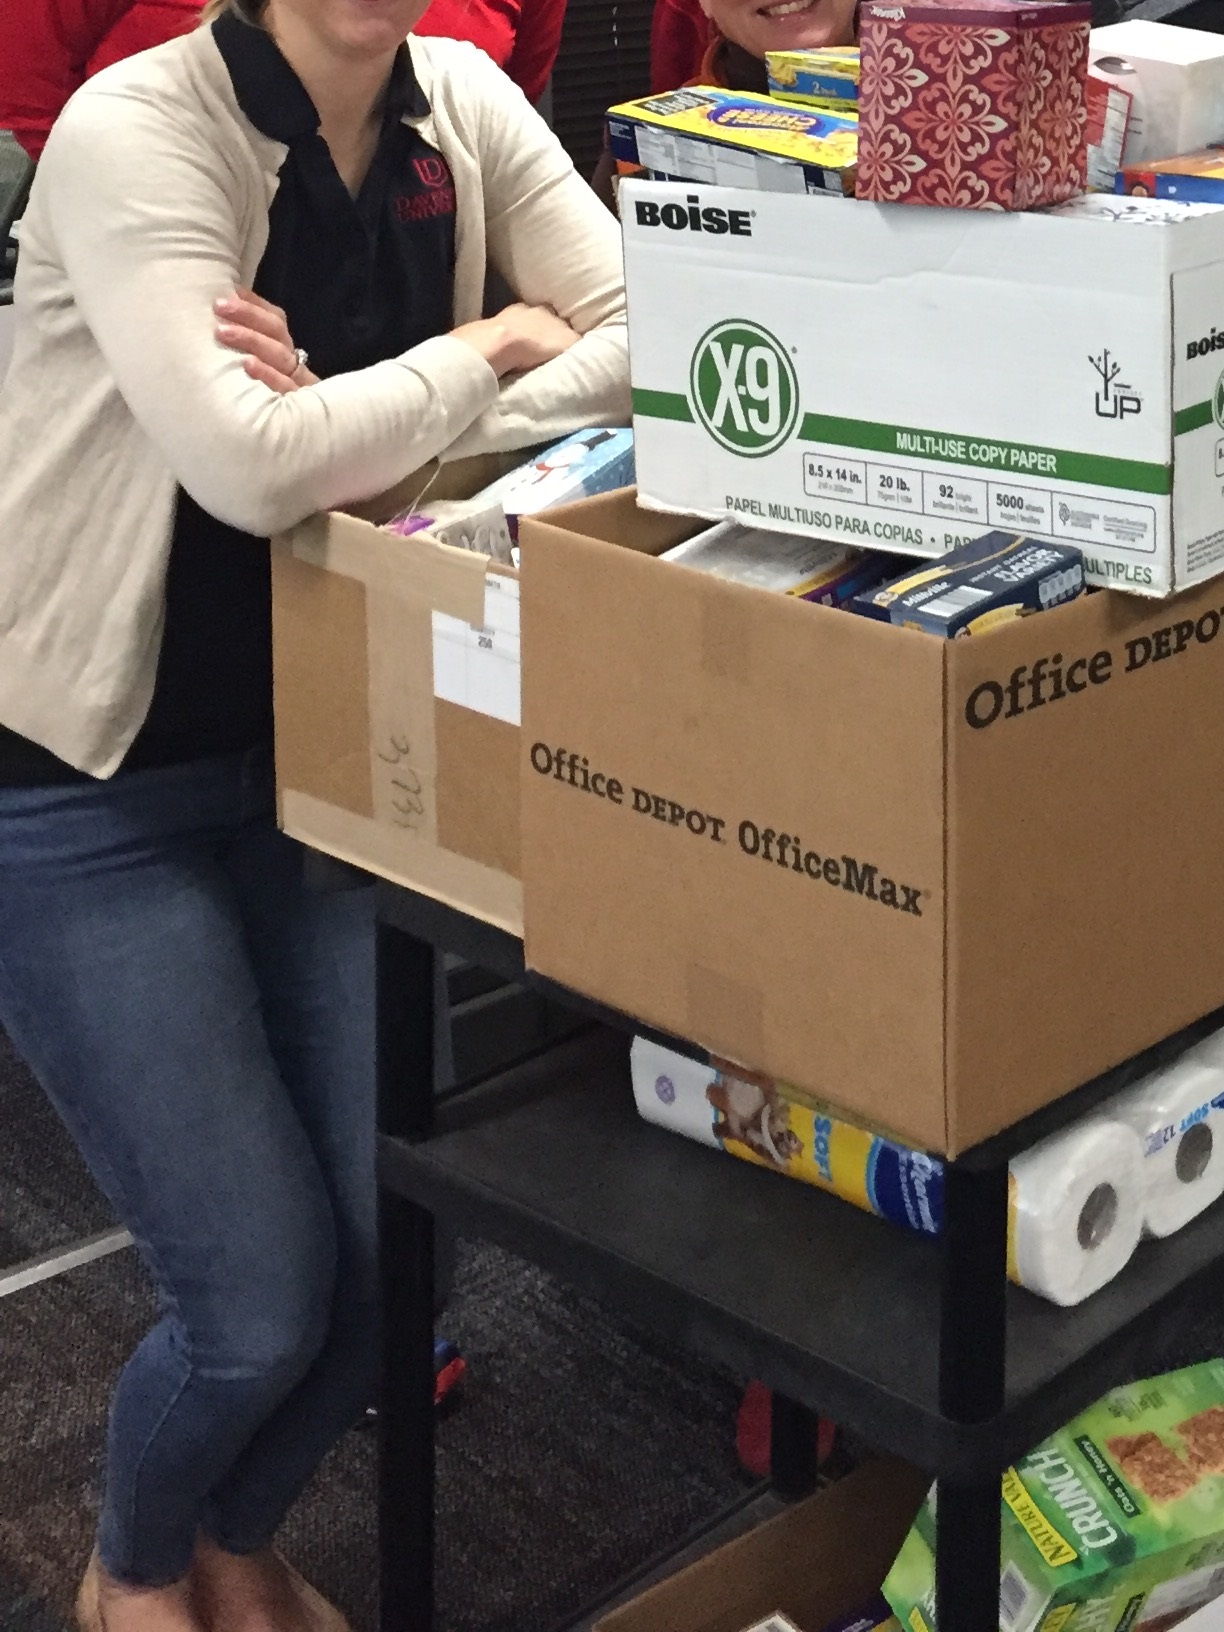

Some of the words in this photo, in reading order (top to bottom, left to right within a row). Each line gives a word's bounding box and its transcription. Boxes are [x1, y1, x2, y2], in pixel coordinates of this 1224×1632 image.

[709, 340, 782, 437] X-9
[808, 463, 823, 478] 8.5
[826, 468, 833, 480] x
[836, 467, 847, 481] 14
[849, 469, 862, 484] in.
[895, 431, 967, 459] MULTI-USE
[968, 443, 1008, 465] COPY
[1010, 448, 1058, 474] PAPER
[879, 474, 894, 489] 20
[896, 476, 911, 492] lb.
[938, 484, 954, 499] 92
[996, 493, 1024, 510] 5000
[725, 495, 766, 517] PAPEL
[768, 503, 832, 529] MULTIUSO
[835, 516, 871, 536] PARA
[873, 522, 923, 546] COPIAS
[944, 533, 973, 549] PAP
[964, 649, 1113, 729] Office
[530, 741, 623, 804] Office
[632, 786, 726, 843] DEPOT
[738, 819, 924, 917] OfficeMax
[1002, 1474, 1022, 1504] VAL
[1026, 1448, 1118, 1549] CRUNCH
[1016, 1504, 1072, 1562] NATURE
